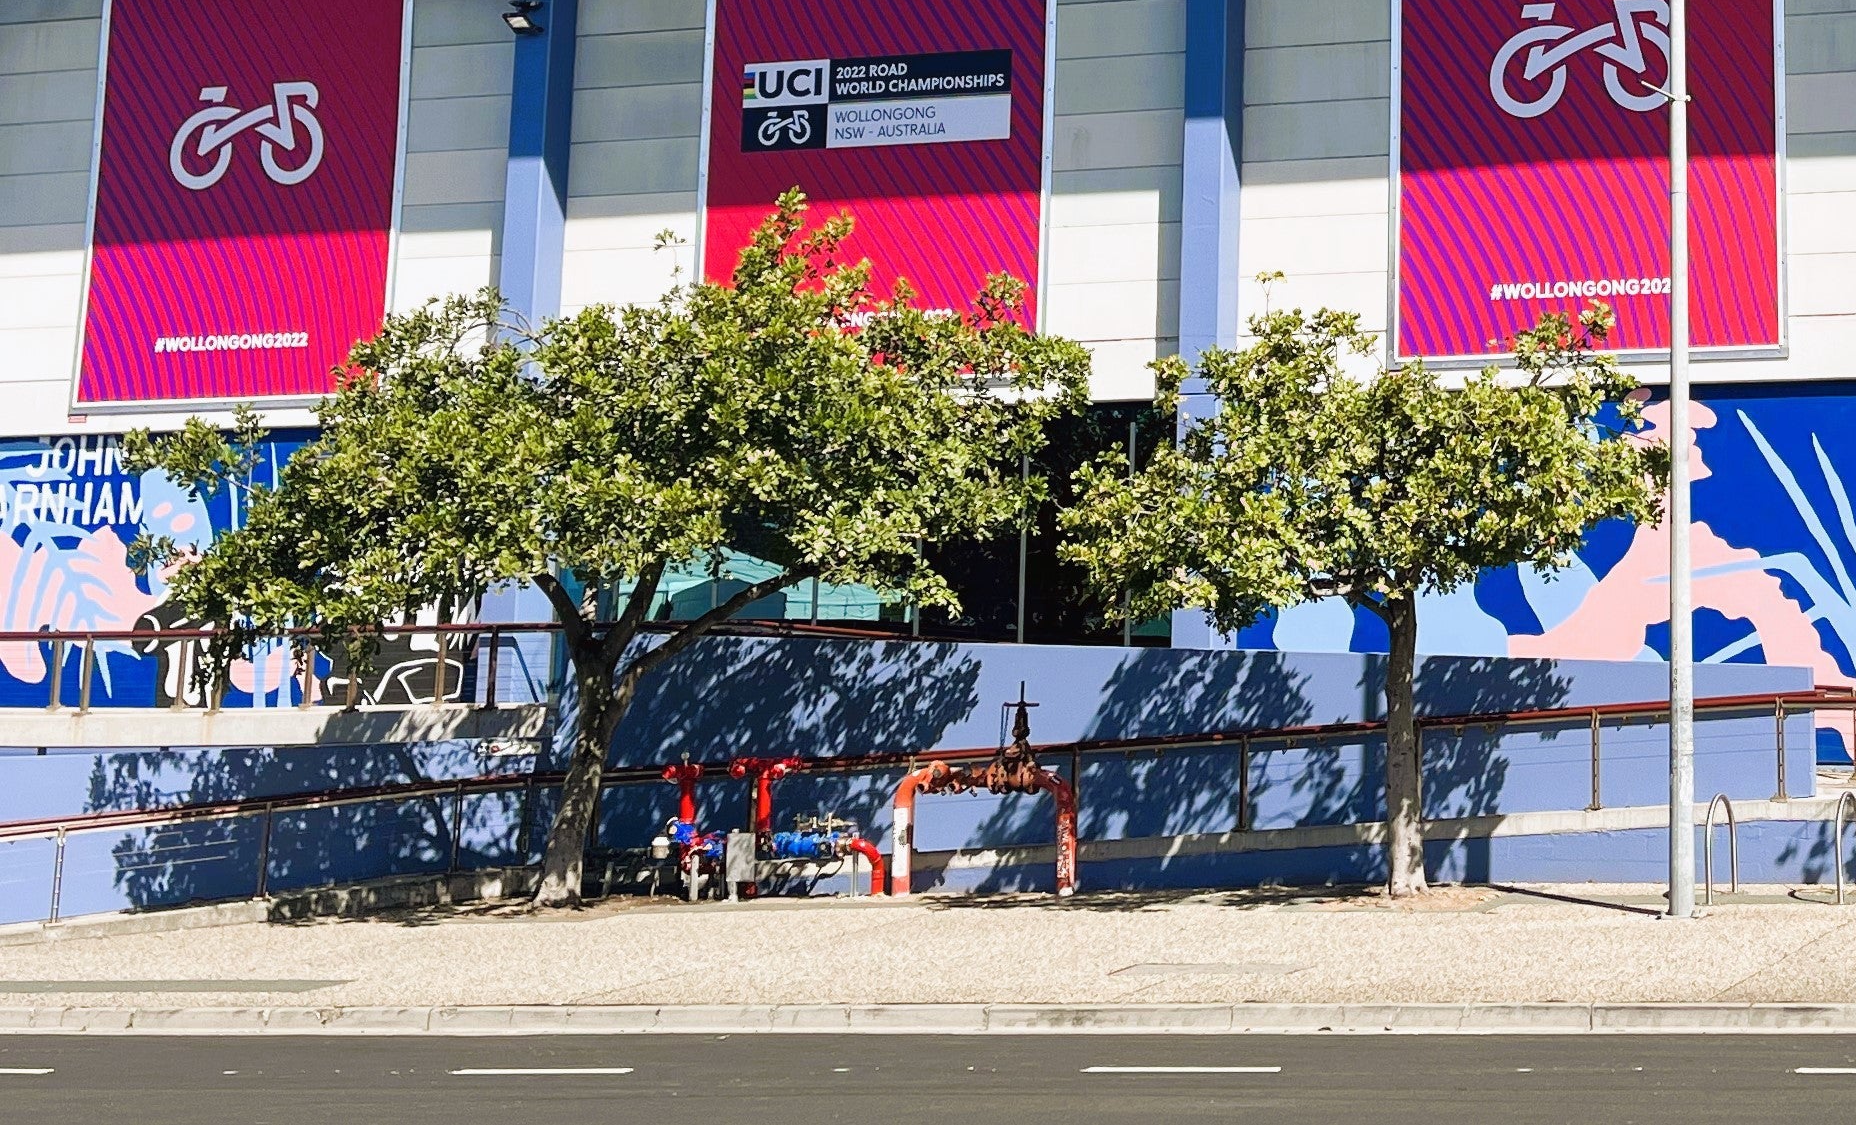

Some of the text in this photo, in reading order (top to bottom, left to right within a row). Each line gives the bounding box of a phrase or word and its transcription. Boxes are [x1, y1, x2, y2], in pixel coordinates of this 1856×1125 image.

[836, 62, 908, 79] 2022 ROAD
[757, 67, 823, 99] UCI
[835, 73, 1005, 95] WORLD CHAMPIONSHIPS
[835, 105, 936, 123] WOLLONGONG
[835, 126, 866, 140] NSW
[876, 122, 946, 138] AUSTRALIA
[154, 331, 309, 353] #WOLLONGONG2022
